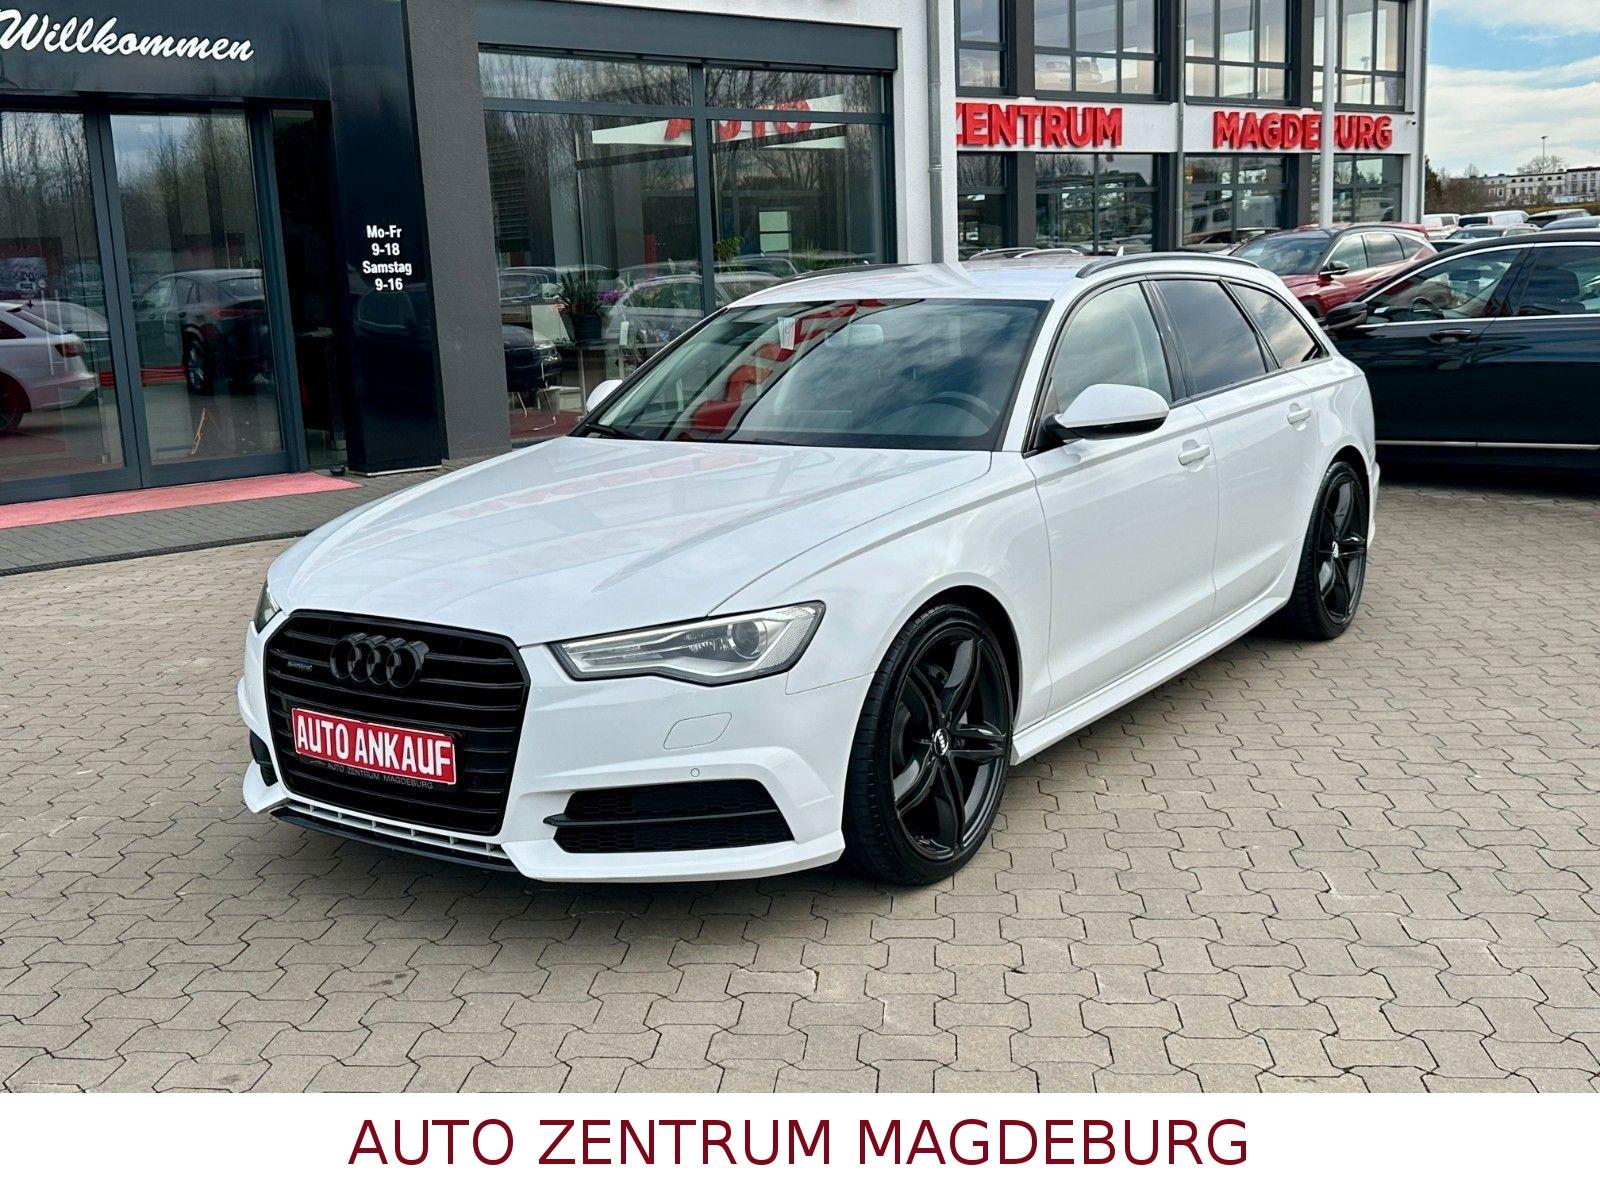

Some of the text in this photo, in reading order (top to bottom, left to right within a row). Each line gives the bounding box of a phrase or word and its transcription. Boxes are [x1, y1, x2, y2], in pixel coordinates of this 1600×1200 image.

[0, 8, 254, 62] Willkommen
[1213, 111, 1393, 150] MAGDEURG
[366, 224, 402, 239] Mo-Fr
[371, 242, 401, 256] 9-18
[362, 260, 412, 276] Samstag
[374, 277, 404, 292] 9-16
[297, 715, 451, 777] AUTO ANKAUF
[327, 762, 434, 790] AUTO ZENTRUM MAGDEBURG
